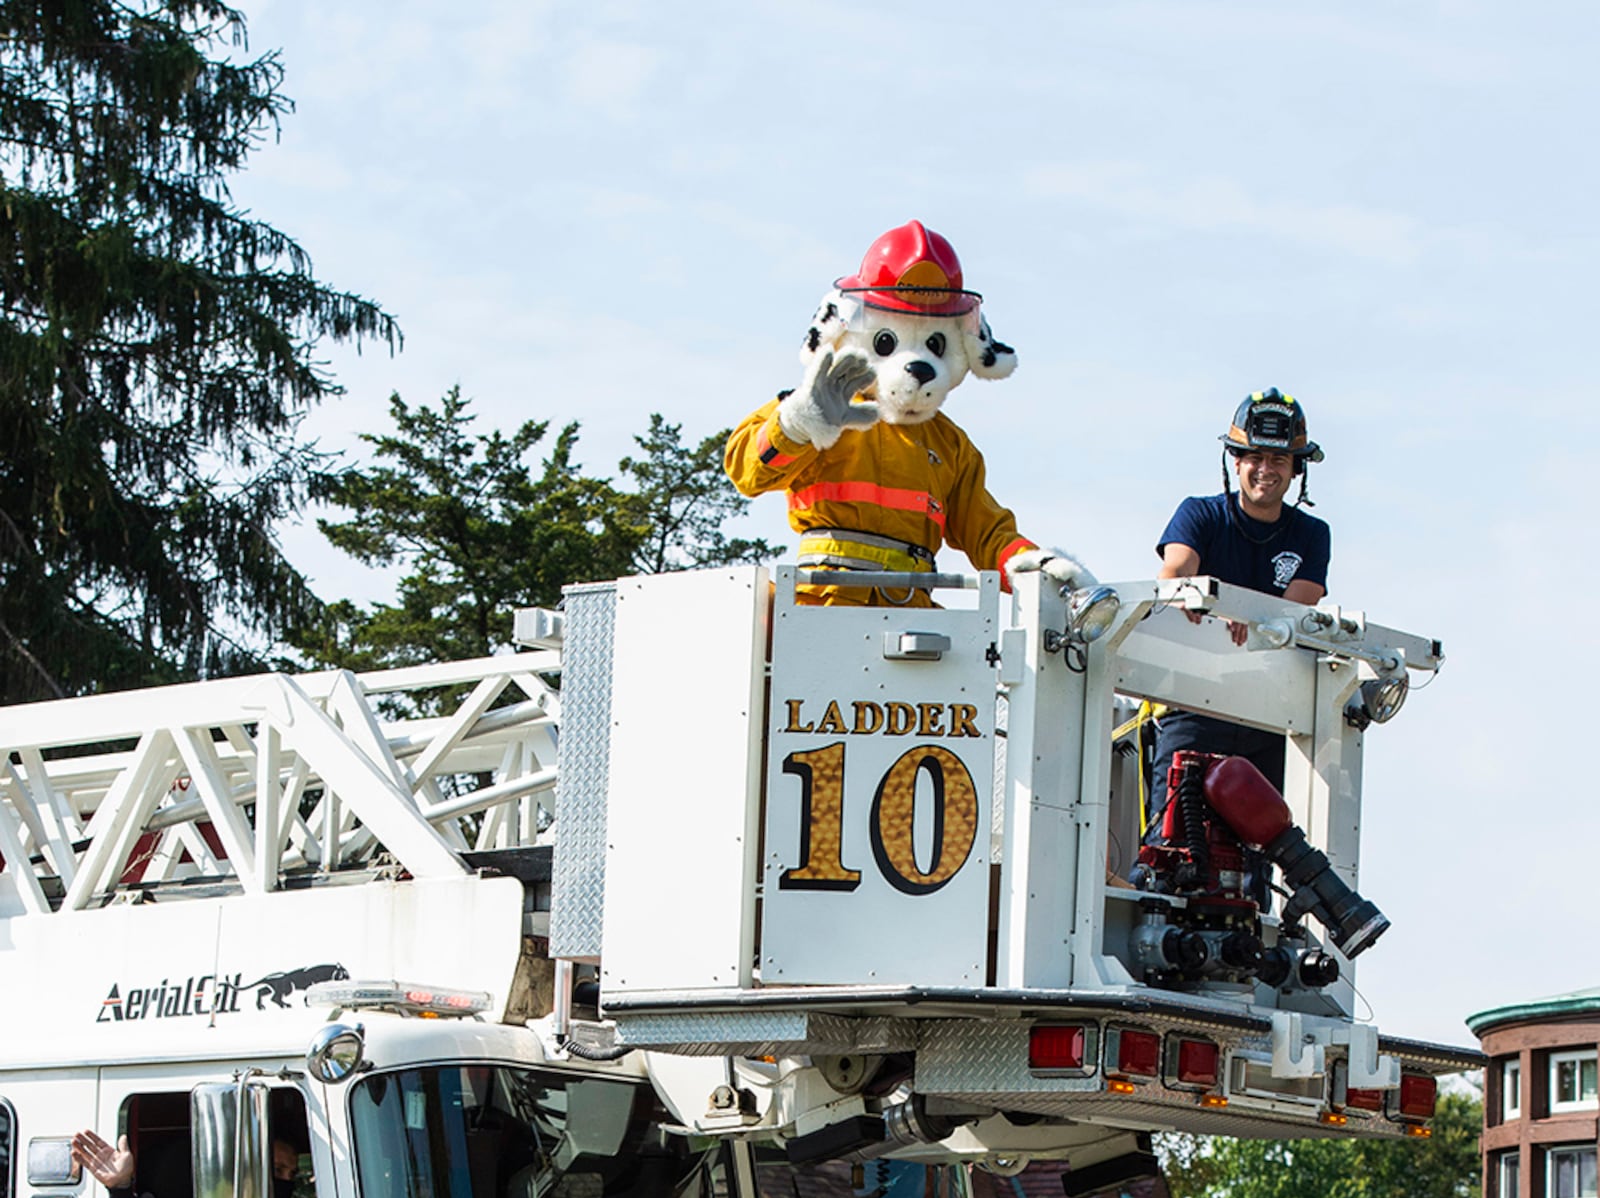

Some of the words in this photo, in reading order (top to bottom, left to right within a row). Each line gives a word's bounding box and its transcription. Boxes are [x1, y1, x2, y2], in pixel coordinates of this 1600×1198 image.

[784, 699, 981, 738] LADDER
[779, 741, 979, 896] 10
[96, 973, 242, 1023] AerialCat
